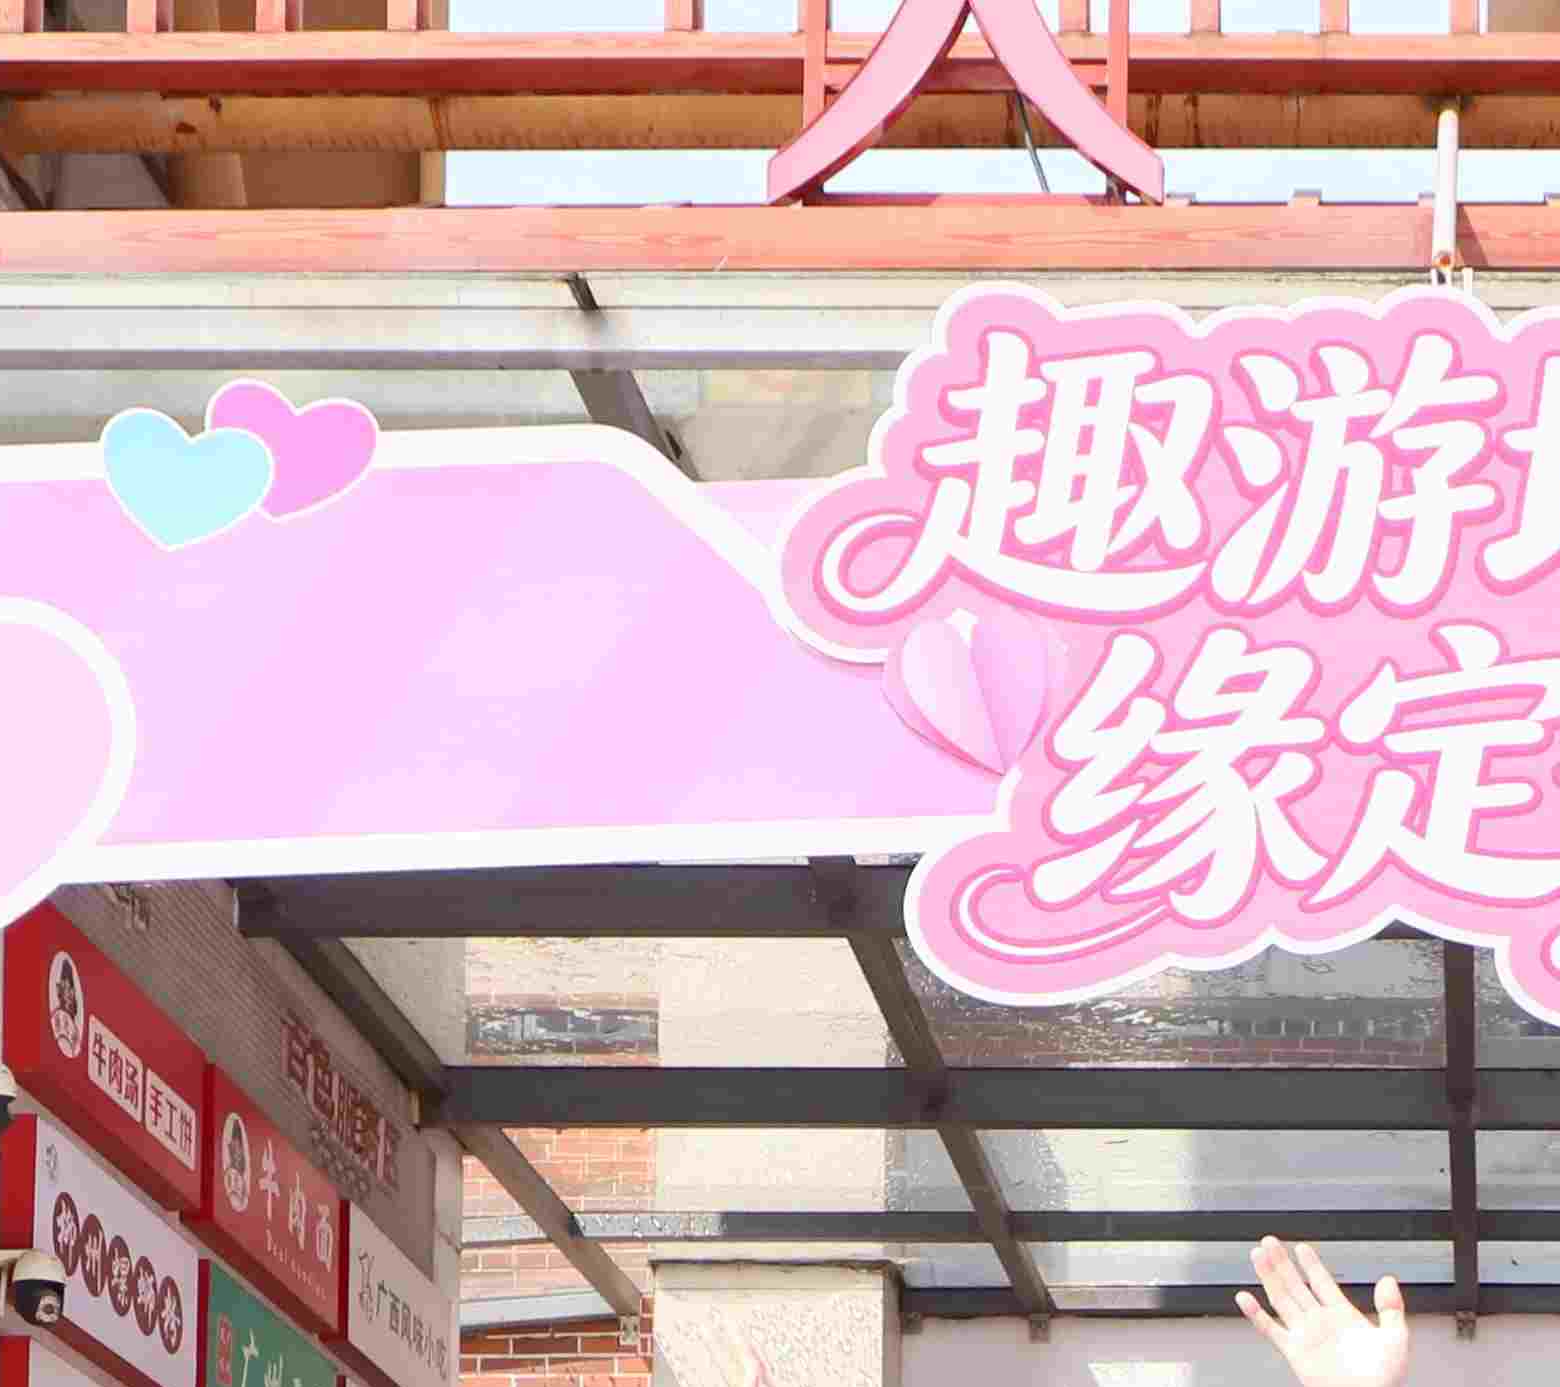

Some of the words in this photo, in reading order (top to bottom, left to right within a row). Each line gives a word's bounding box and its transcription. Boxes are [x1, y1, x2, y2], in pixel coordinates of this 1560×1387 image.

[92, 1030, 140, 1112] 牛肉汤
[149, 1083, 195, 1161] 手工饼
